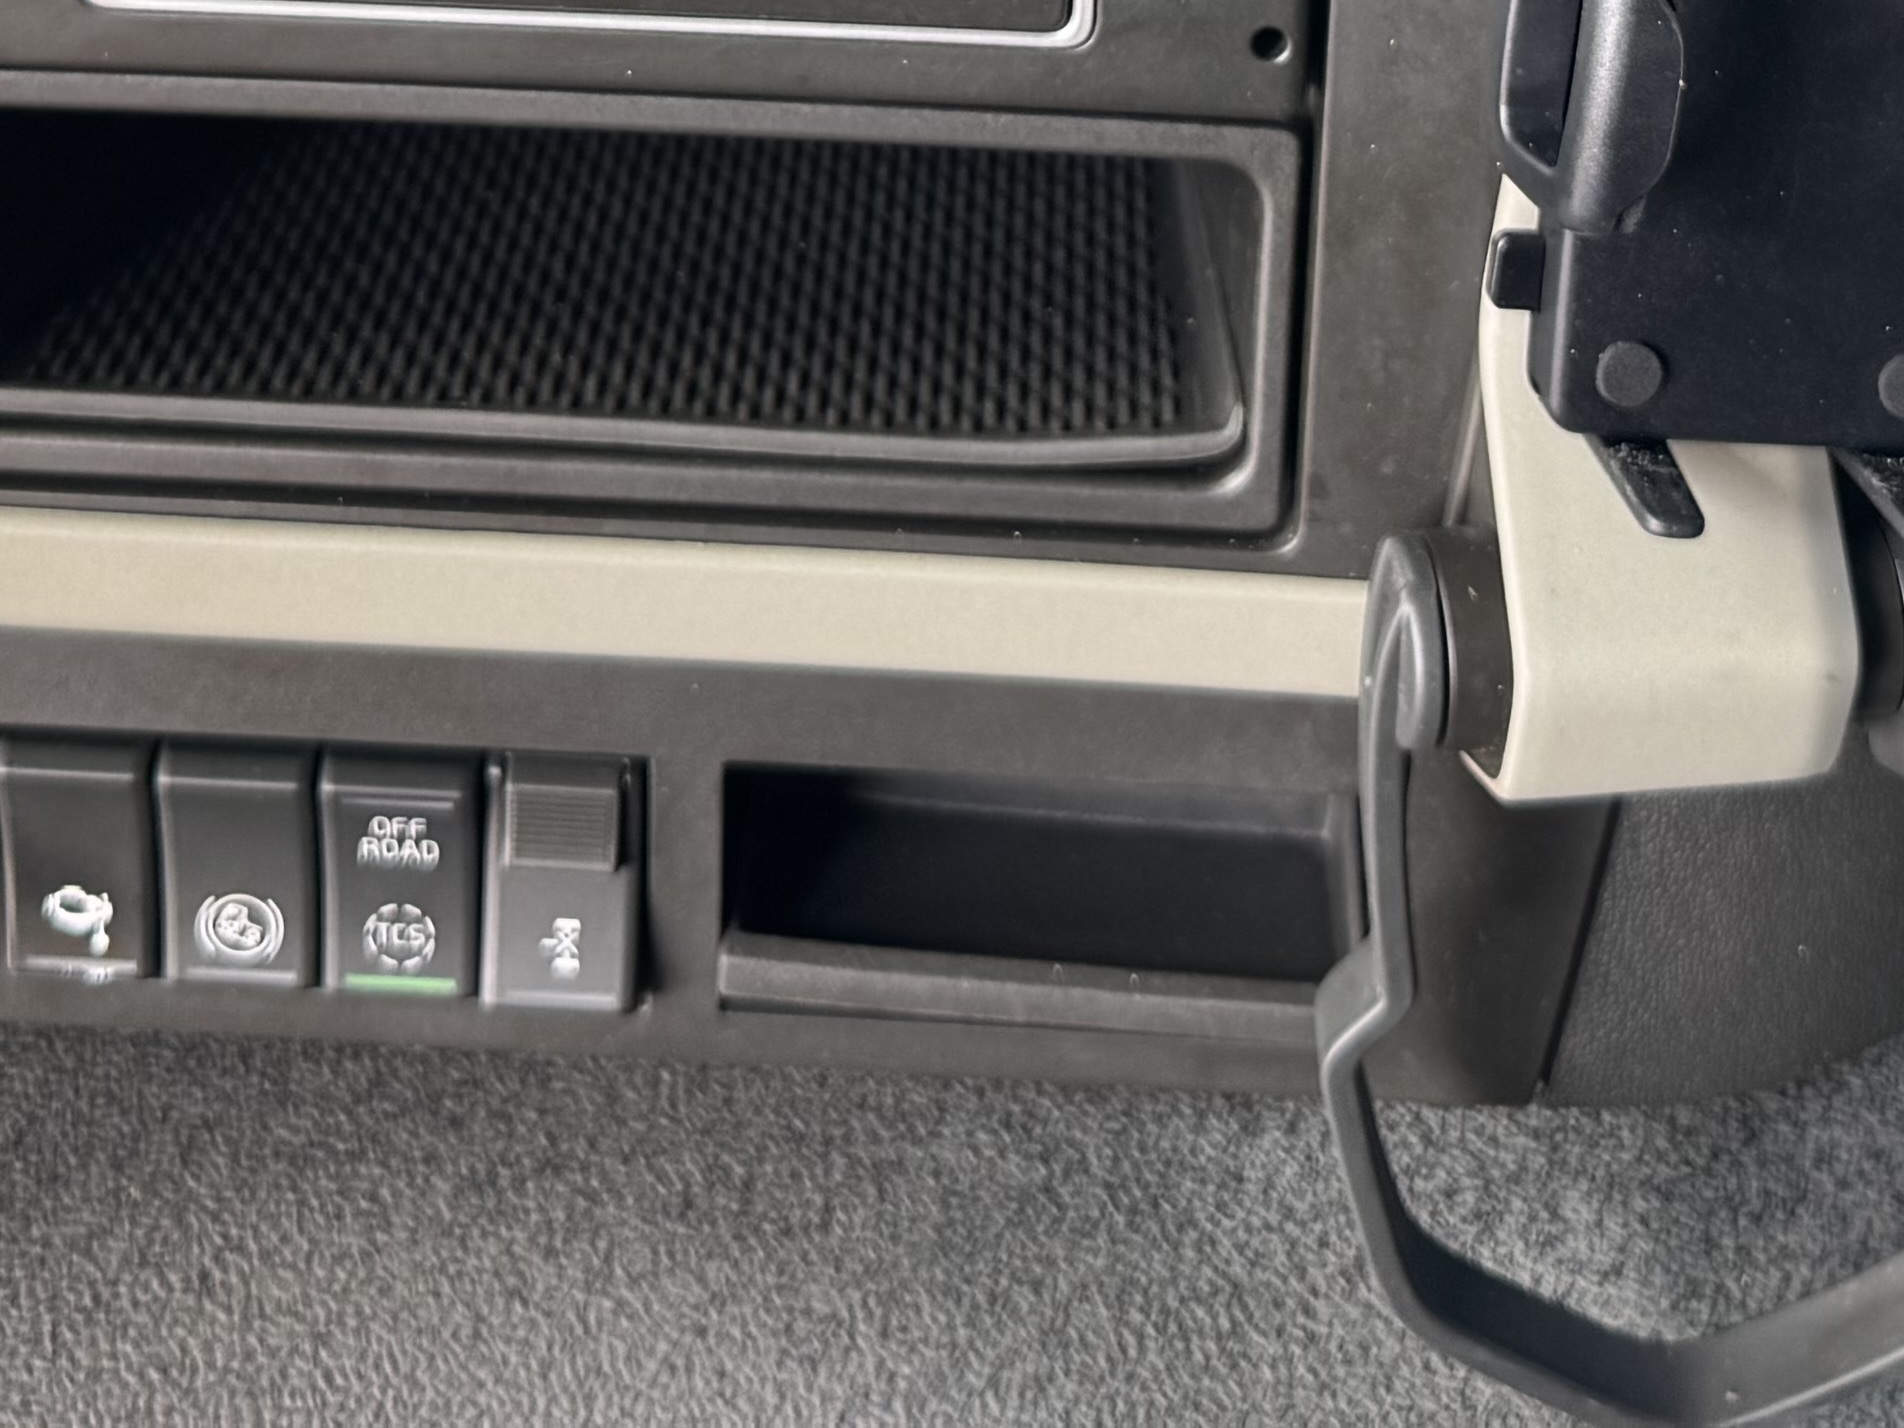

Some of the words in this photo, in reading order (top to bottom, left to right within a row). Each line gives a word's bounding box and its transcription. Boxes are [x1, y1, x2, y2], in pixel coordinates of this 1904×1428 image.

[367, 816, 428, 839] OFF
[357, 837, 440, 868] ROAD
[375, 922, 426, 952] TCS
